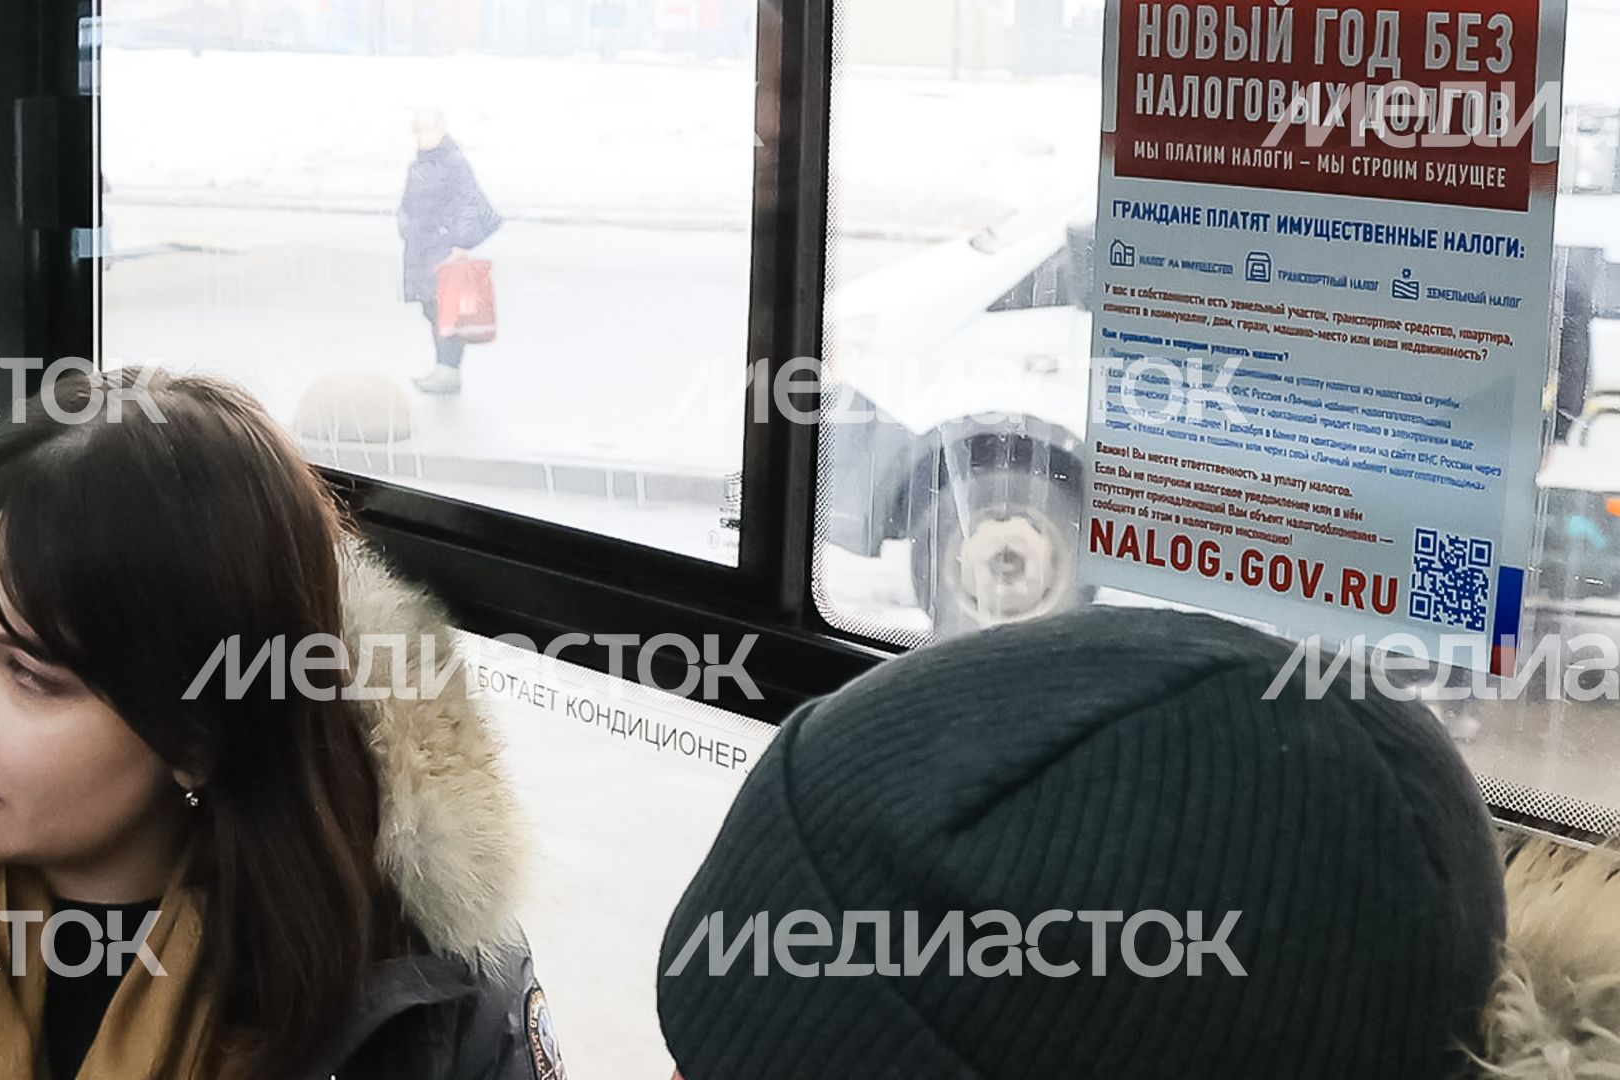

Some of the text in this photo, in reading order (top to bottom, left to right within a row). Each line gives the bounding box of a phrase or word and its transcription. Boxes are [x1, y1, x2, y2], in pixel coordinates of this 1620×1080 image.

[1137, 0, 1514, 79] НОВЫЙ ГОД БЕЗ
[1135, 72, 1510, 138] НАЛОГОВЫХ ДОЛГОВ
[1134, 141, 1159, 159] МЫ
[1165, 142, 1225, 165] ПЛАТИМ
[1232, 148, 1293, 170] НАЛОГИ
[1317, 154, 1345, 174] МЫ
[1352, 156, 1418, 180] СТРОИМ
[1425, 161, 1507, 190] БУДУЩЕЕ
[1112, 200, 1525, 259] ГРАЖДАНЕ ПЛАТЯТ ИМУЩЕСТВЕННЫЕ НАЛОГИ:
[1089, 517, 1399, 615] NALOG.GOV.RU
[476, 660, 559, 711] БОТАЕТ
